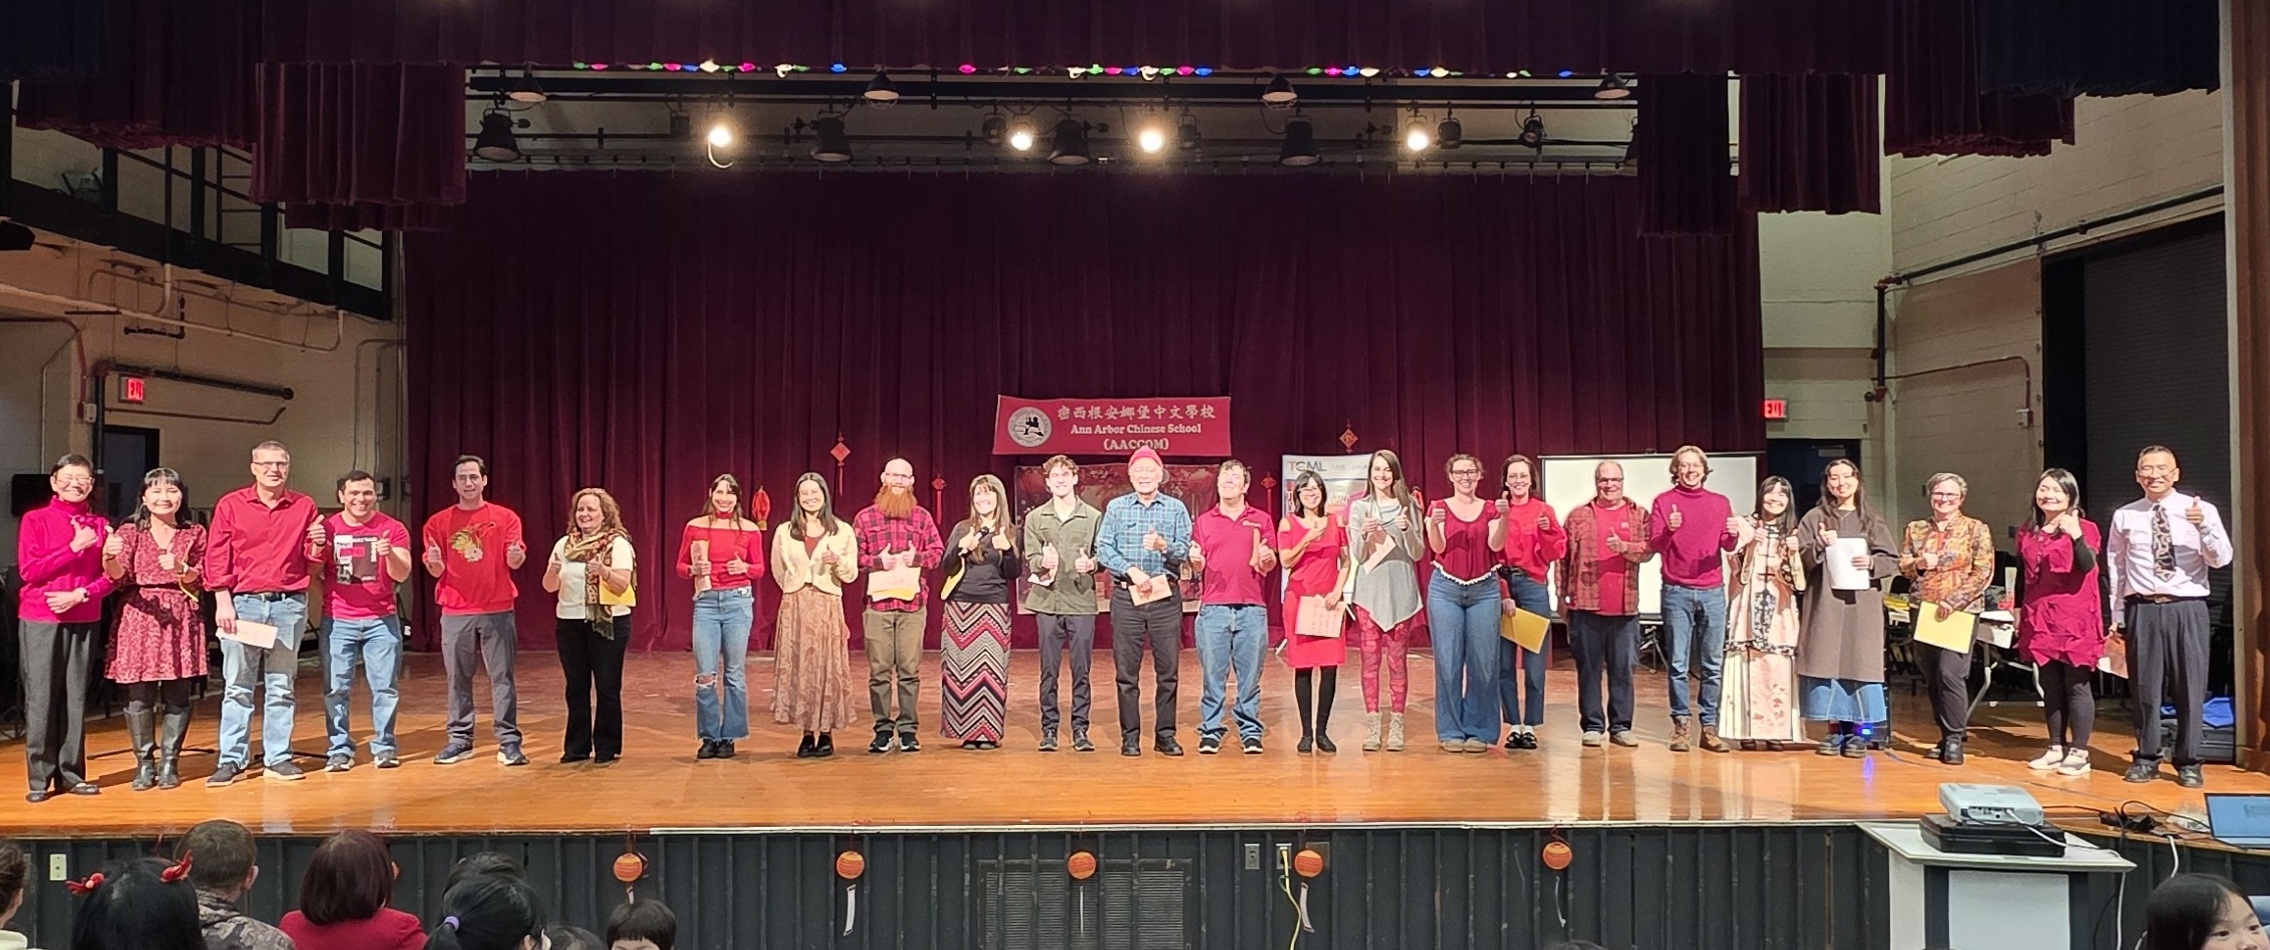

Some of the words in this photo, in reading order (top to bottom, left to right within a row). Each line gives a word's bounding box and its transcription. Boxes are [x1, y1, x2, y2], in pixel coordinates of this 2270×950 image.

[1057, 404, 1216, 420] 密西根安娜堡中文學校
[1070, 424, 1093, 434] Ann
[1094, 424, 1125, 434] Arbor
[1126, 424, 1166, 434] Chinese
[1167, 423, 1202, 434] School
